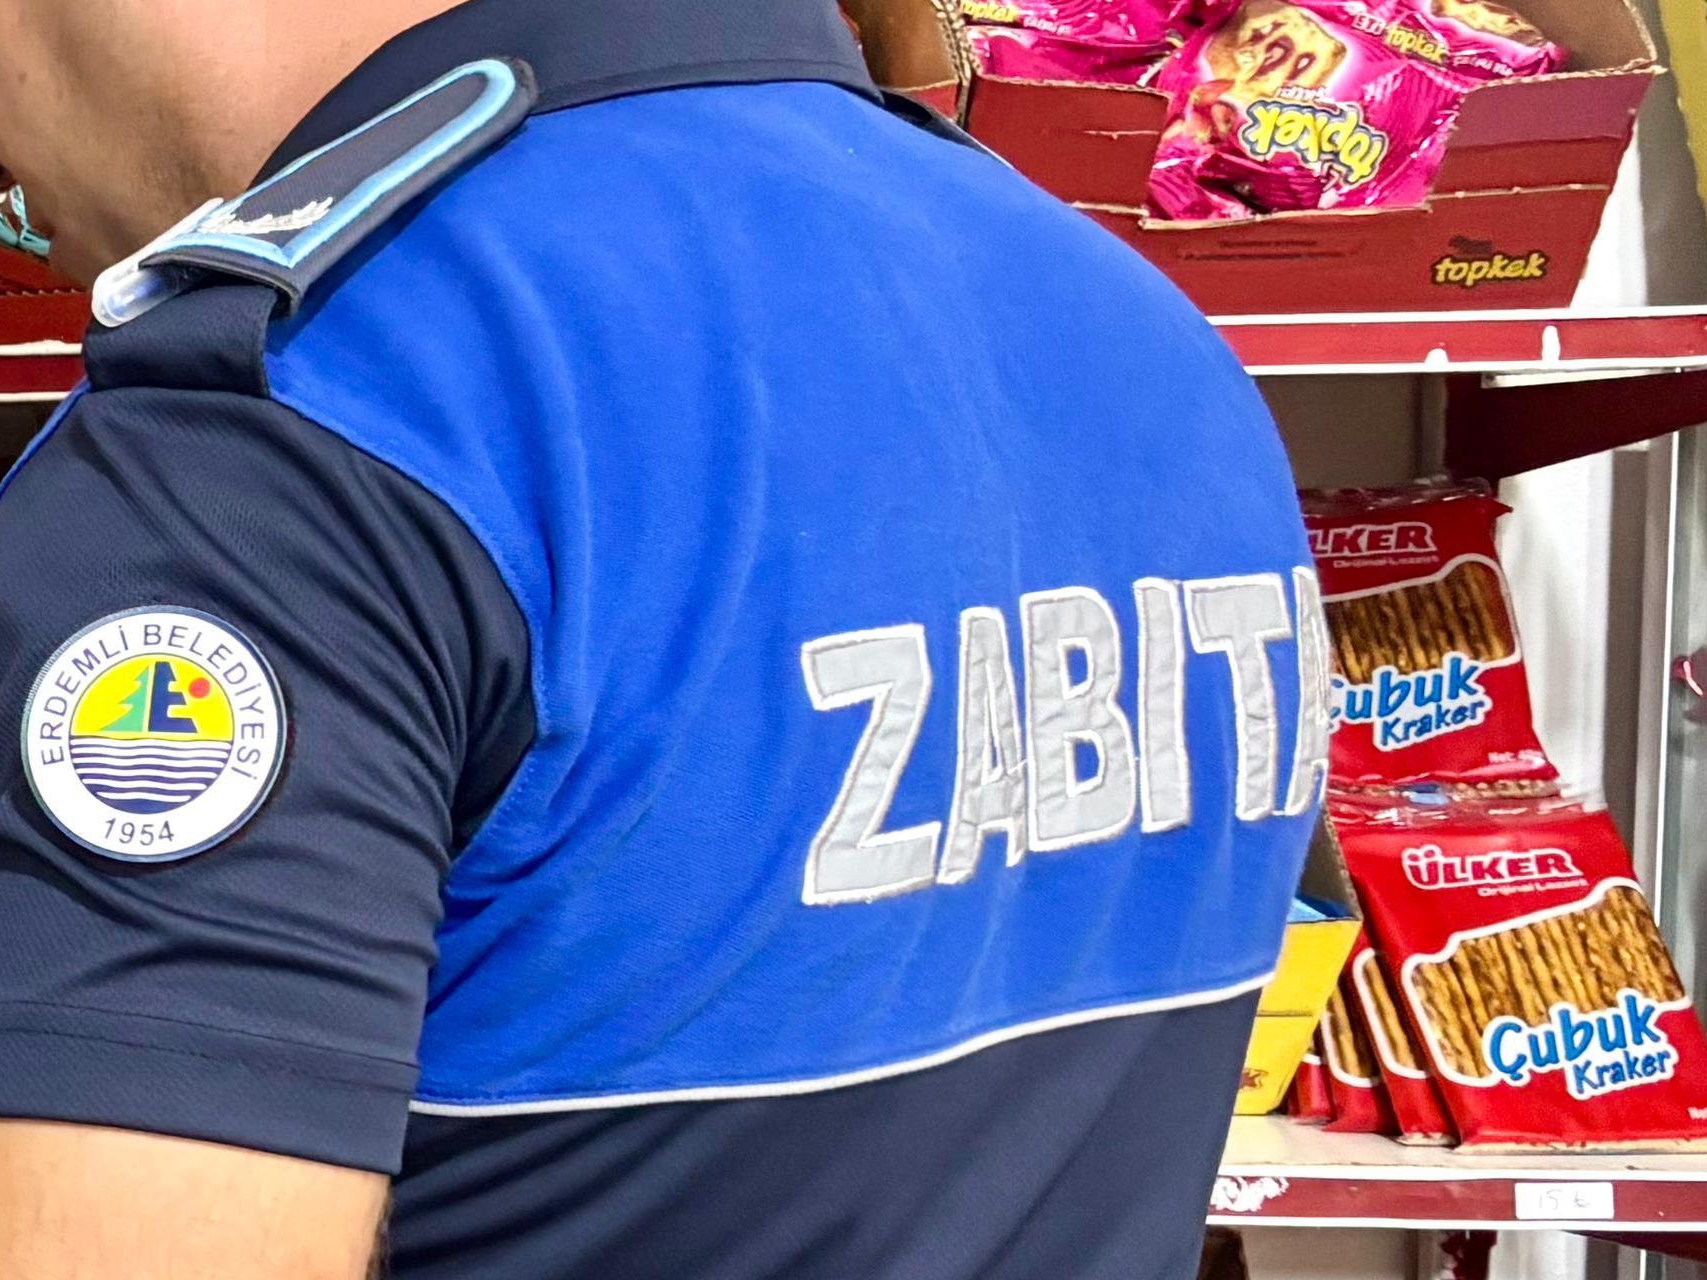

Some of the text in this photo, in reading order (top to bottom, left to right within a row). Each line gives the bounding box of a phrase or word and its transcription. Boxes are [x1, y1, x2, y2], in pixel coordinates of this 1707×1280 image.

[1434, 252, 1549, 288] topkek
[1305, 520, 1438, 559] LKER
[40, 624, 265, 781] ERDEMLİ BELEDİYESİ
[1379, 695, 1490, 751] Kraker
[103, 818, 175, 846] 1954
[1400, 843, 1584, 891] ÜLKER
[1487, 987, 1663, 1084] Çubuk
[1569, 1040, 1677, 1099] Kraker
